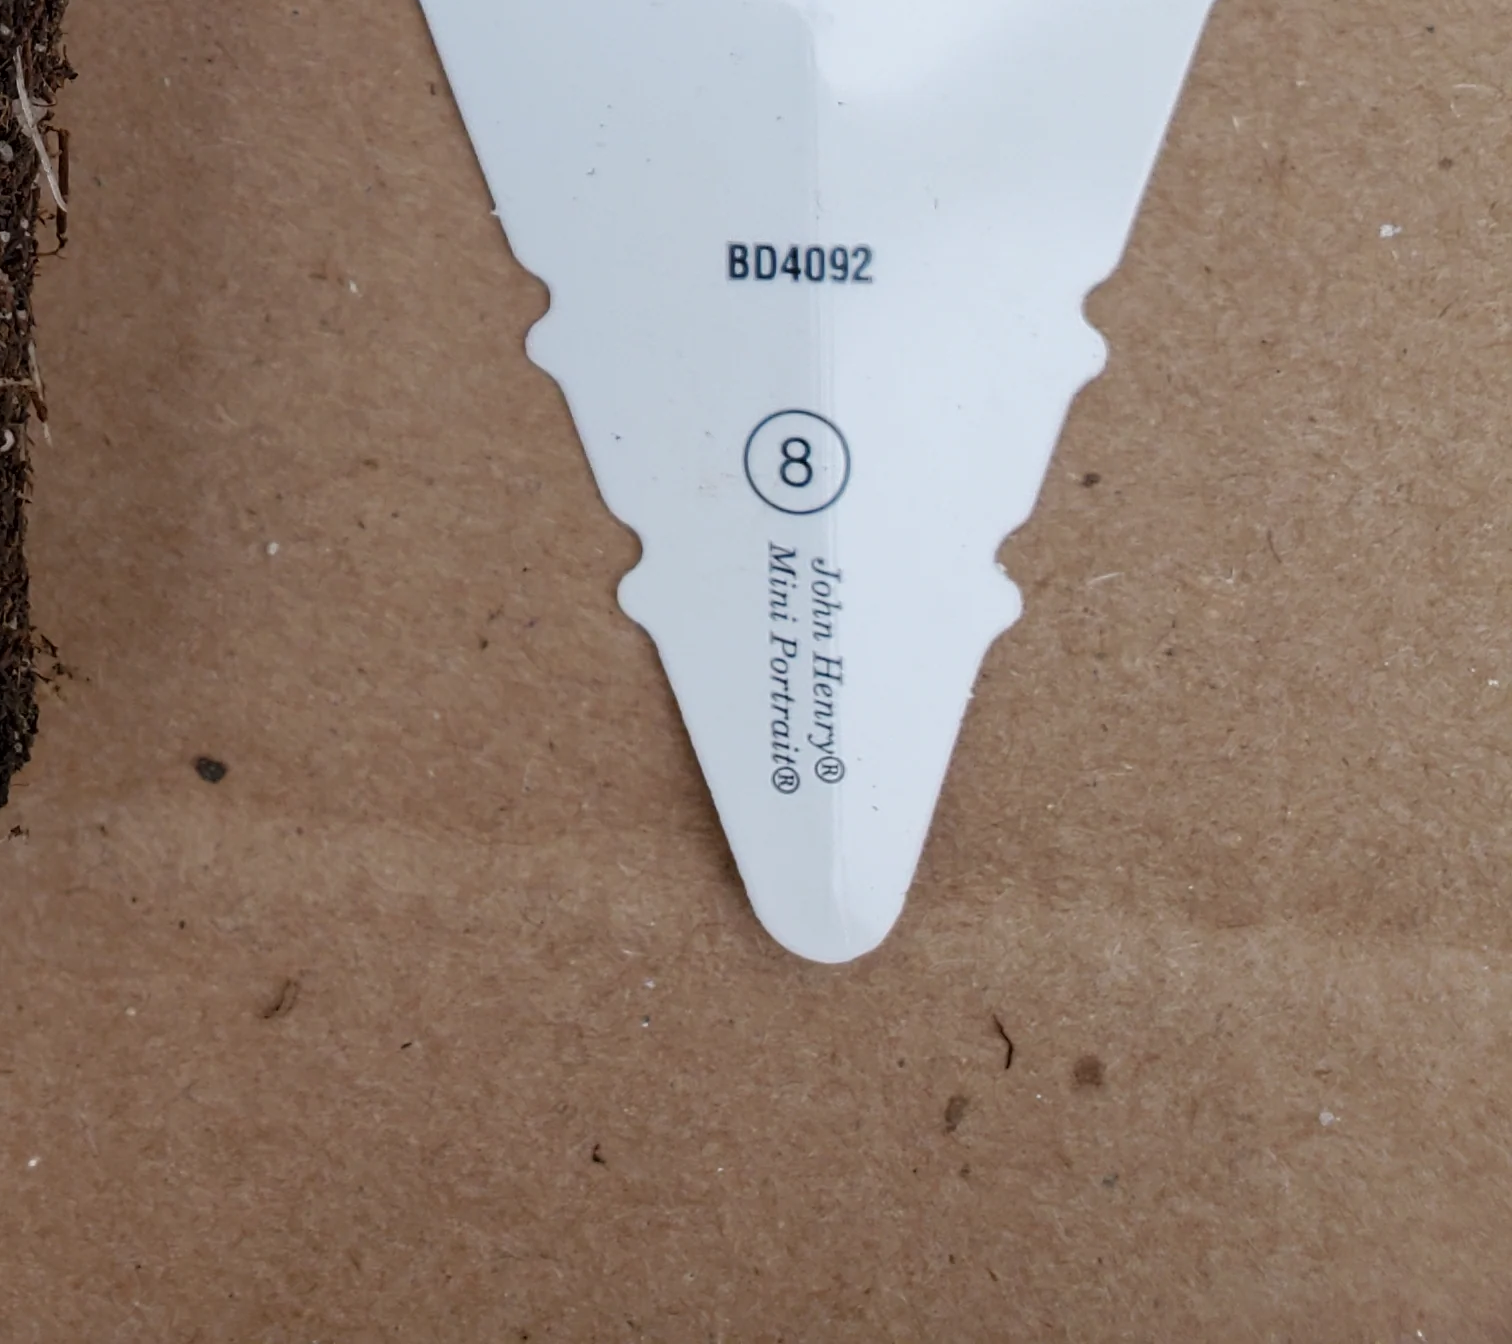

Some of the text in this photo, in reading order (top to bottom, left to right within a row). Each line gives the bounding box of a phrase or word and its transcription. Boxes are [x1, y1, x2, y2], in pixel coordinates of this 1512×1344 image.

[727, 243, 874, 284] BD4092
[779, 437, 813, 487] 8
[768, 541, 798, 623] Mini
[811, 557, 843, 642] John
